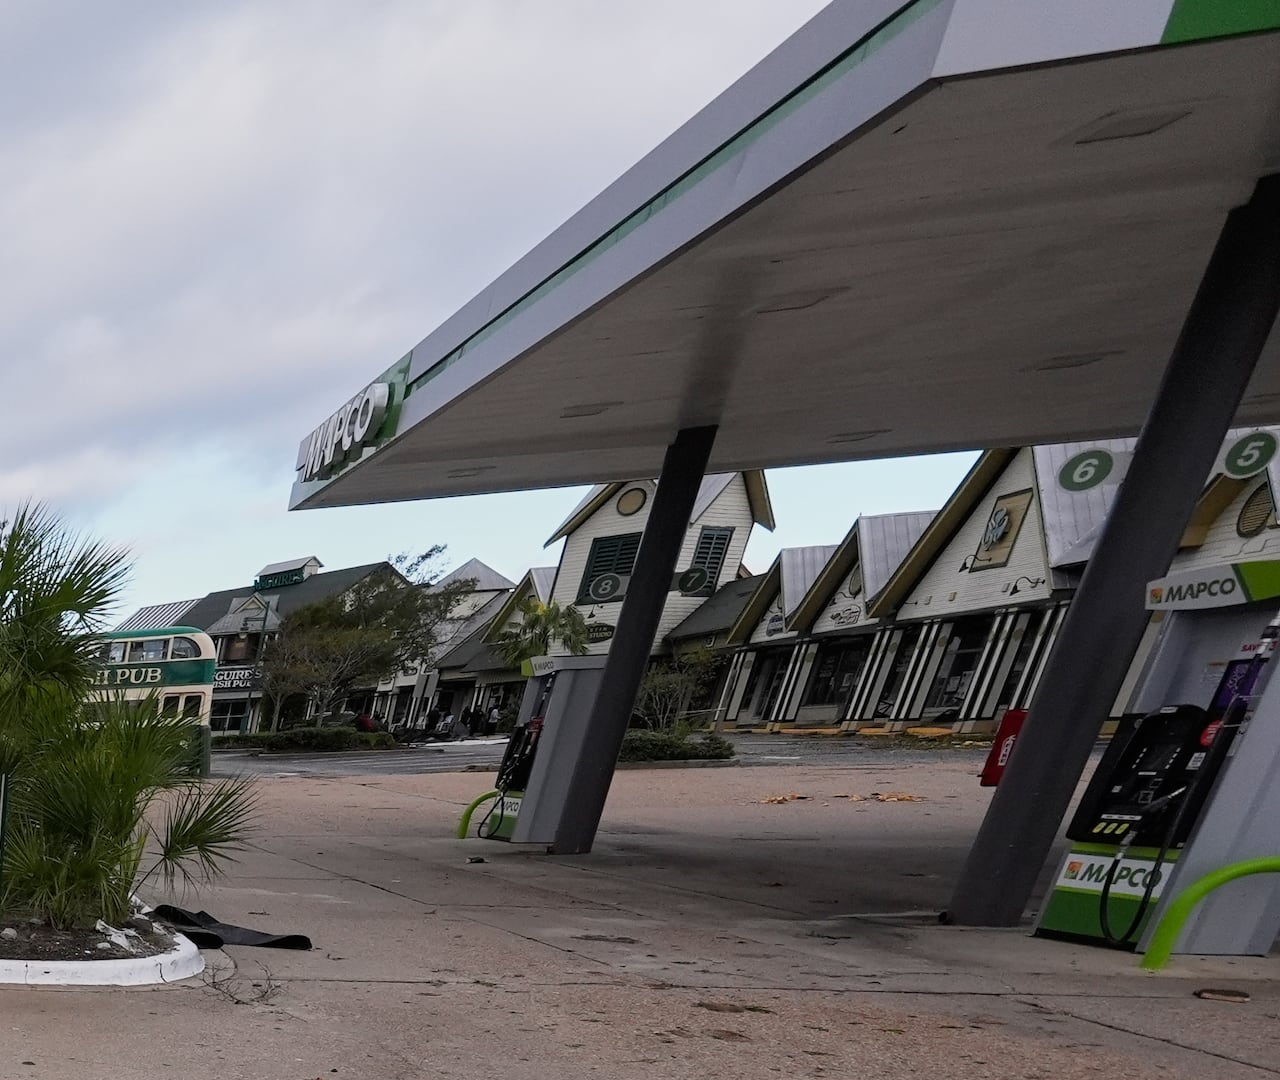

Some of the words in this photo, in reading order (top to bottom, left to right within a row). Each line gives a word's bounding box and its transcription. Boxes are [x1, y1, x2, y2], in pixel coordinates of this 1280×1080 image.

[301, 383, 388, 483] MAPCO
[1237, 441, 1265, 467] 5
[1072, 458, 1099, 483] 6
[1165, 578, 1236, 602] MAPCO
[114, 668, 162, 684] PUB
